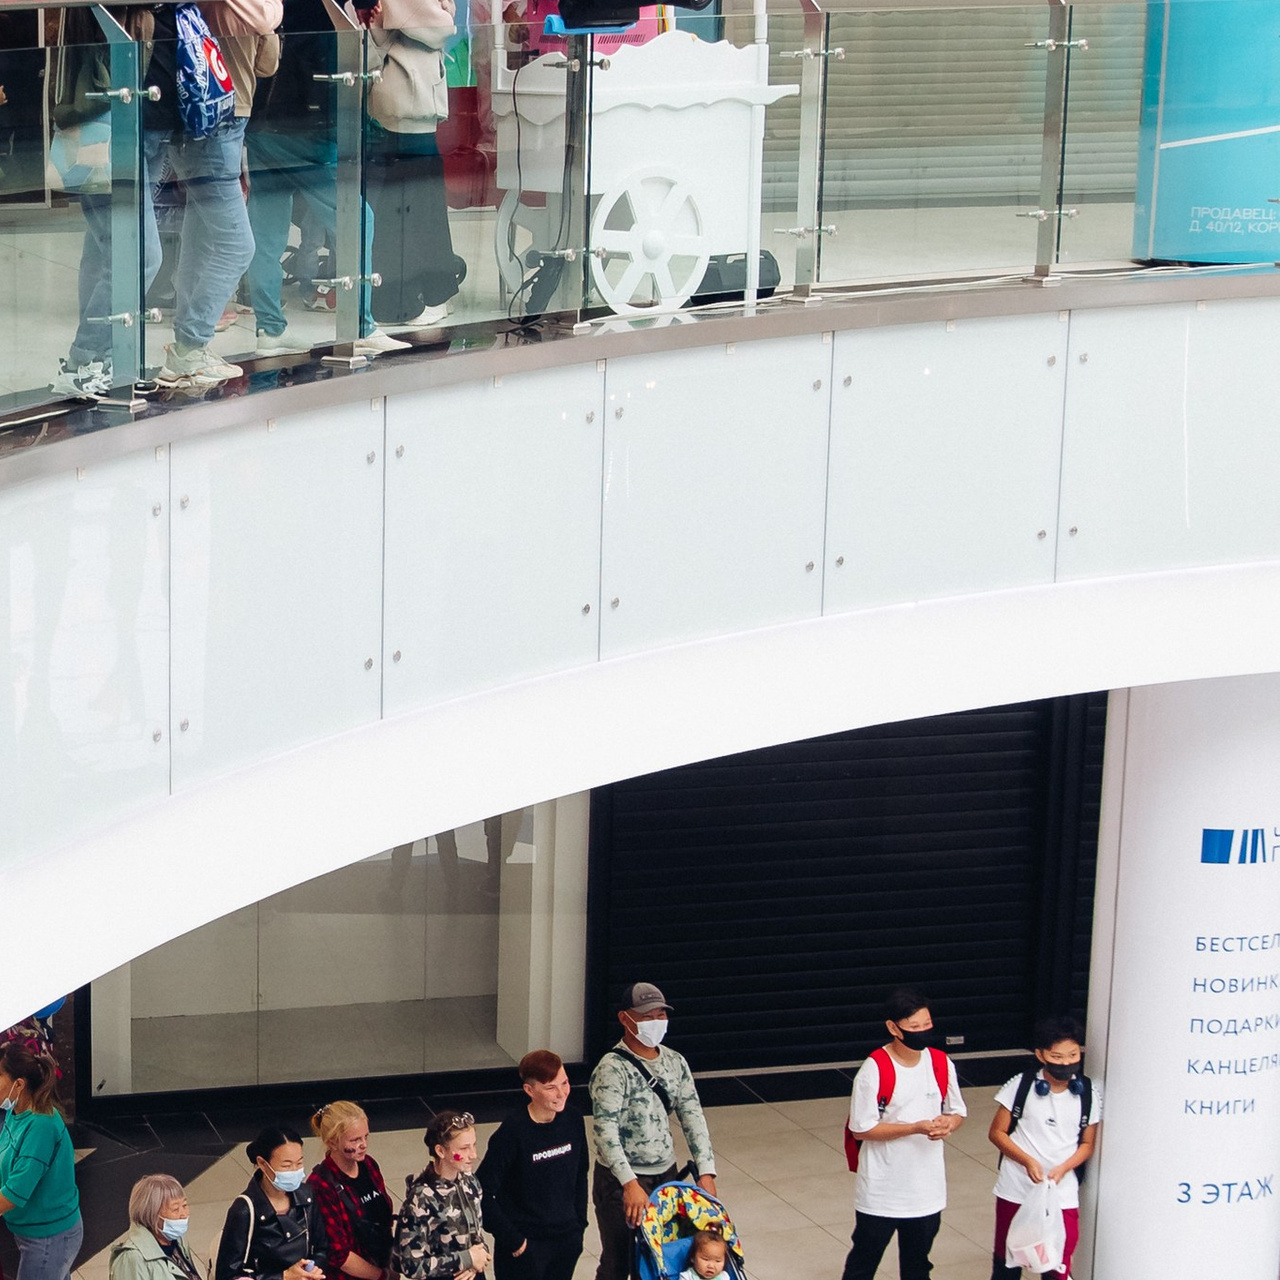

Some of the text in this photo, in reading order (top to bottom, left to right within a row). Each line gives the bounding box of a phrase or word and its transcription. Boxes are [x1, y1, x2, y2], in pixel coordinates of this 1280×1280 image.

[1191, 206, 1276, 220] ПРОДАВЕЦ:
[1206, 222, 1245, 236] 40/12,
[1187, 1053, 1280, 1076] КАНЦЕЛЯ
[1184, 1098, 1255, 1115] КНИГИ
[1177, 1174, 1274, 1205] 3 ЭТАЖ
